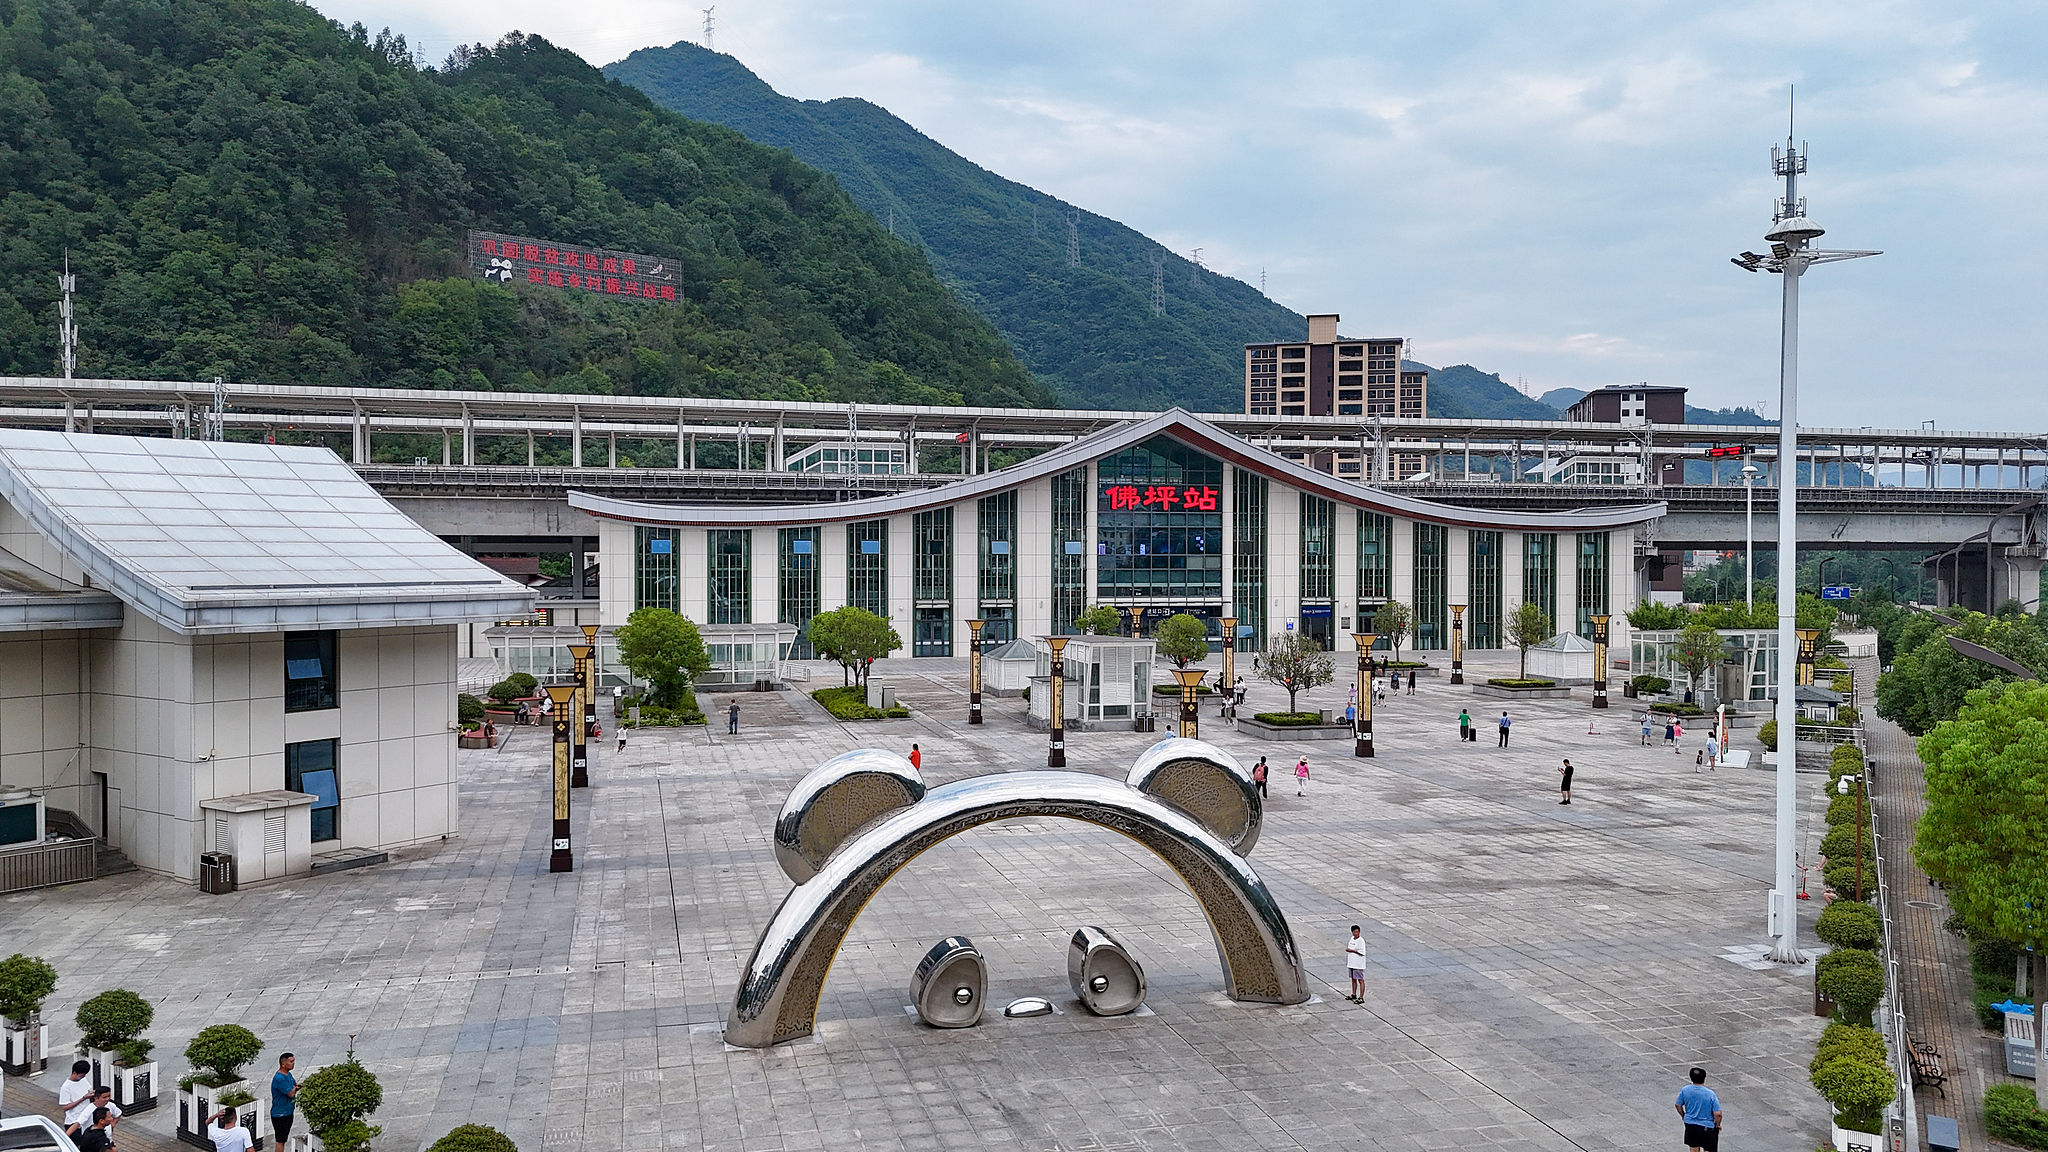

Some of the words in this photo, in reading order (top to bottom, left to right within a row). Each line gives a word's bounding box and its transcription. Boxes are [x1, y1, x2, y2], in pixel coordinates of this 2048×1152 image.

[481, 239, 636, 275] 巩固脱贫攻坚成果
[527, 267, 676, 301] 实施乡村振兴战略
[1105, 485, 1219, 511] 佛坪站
